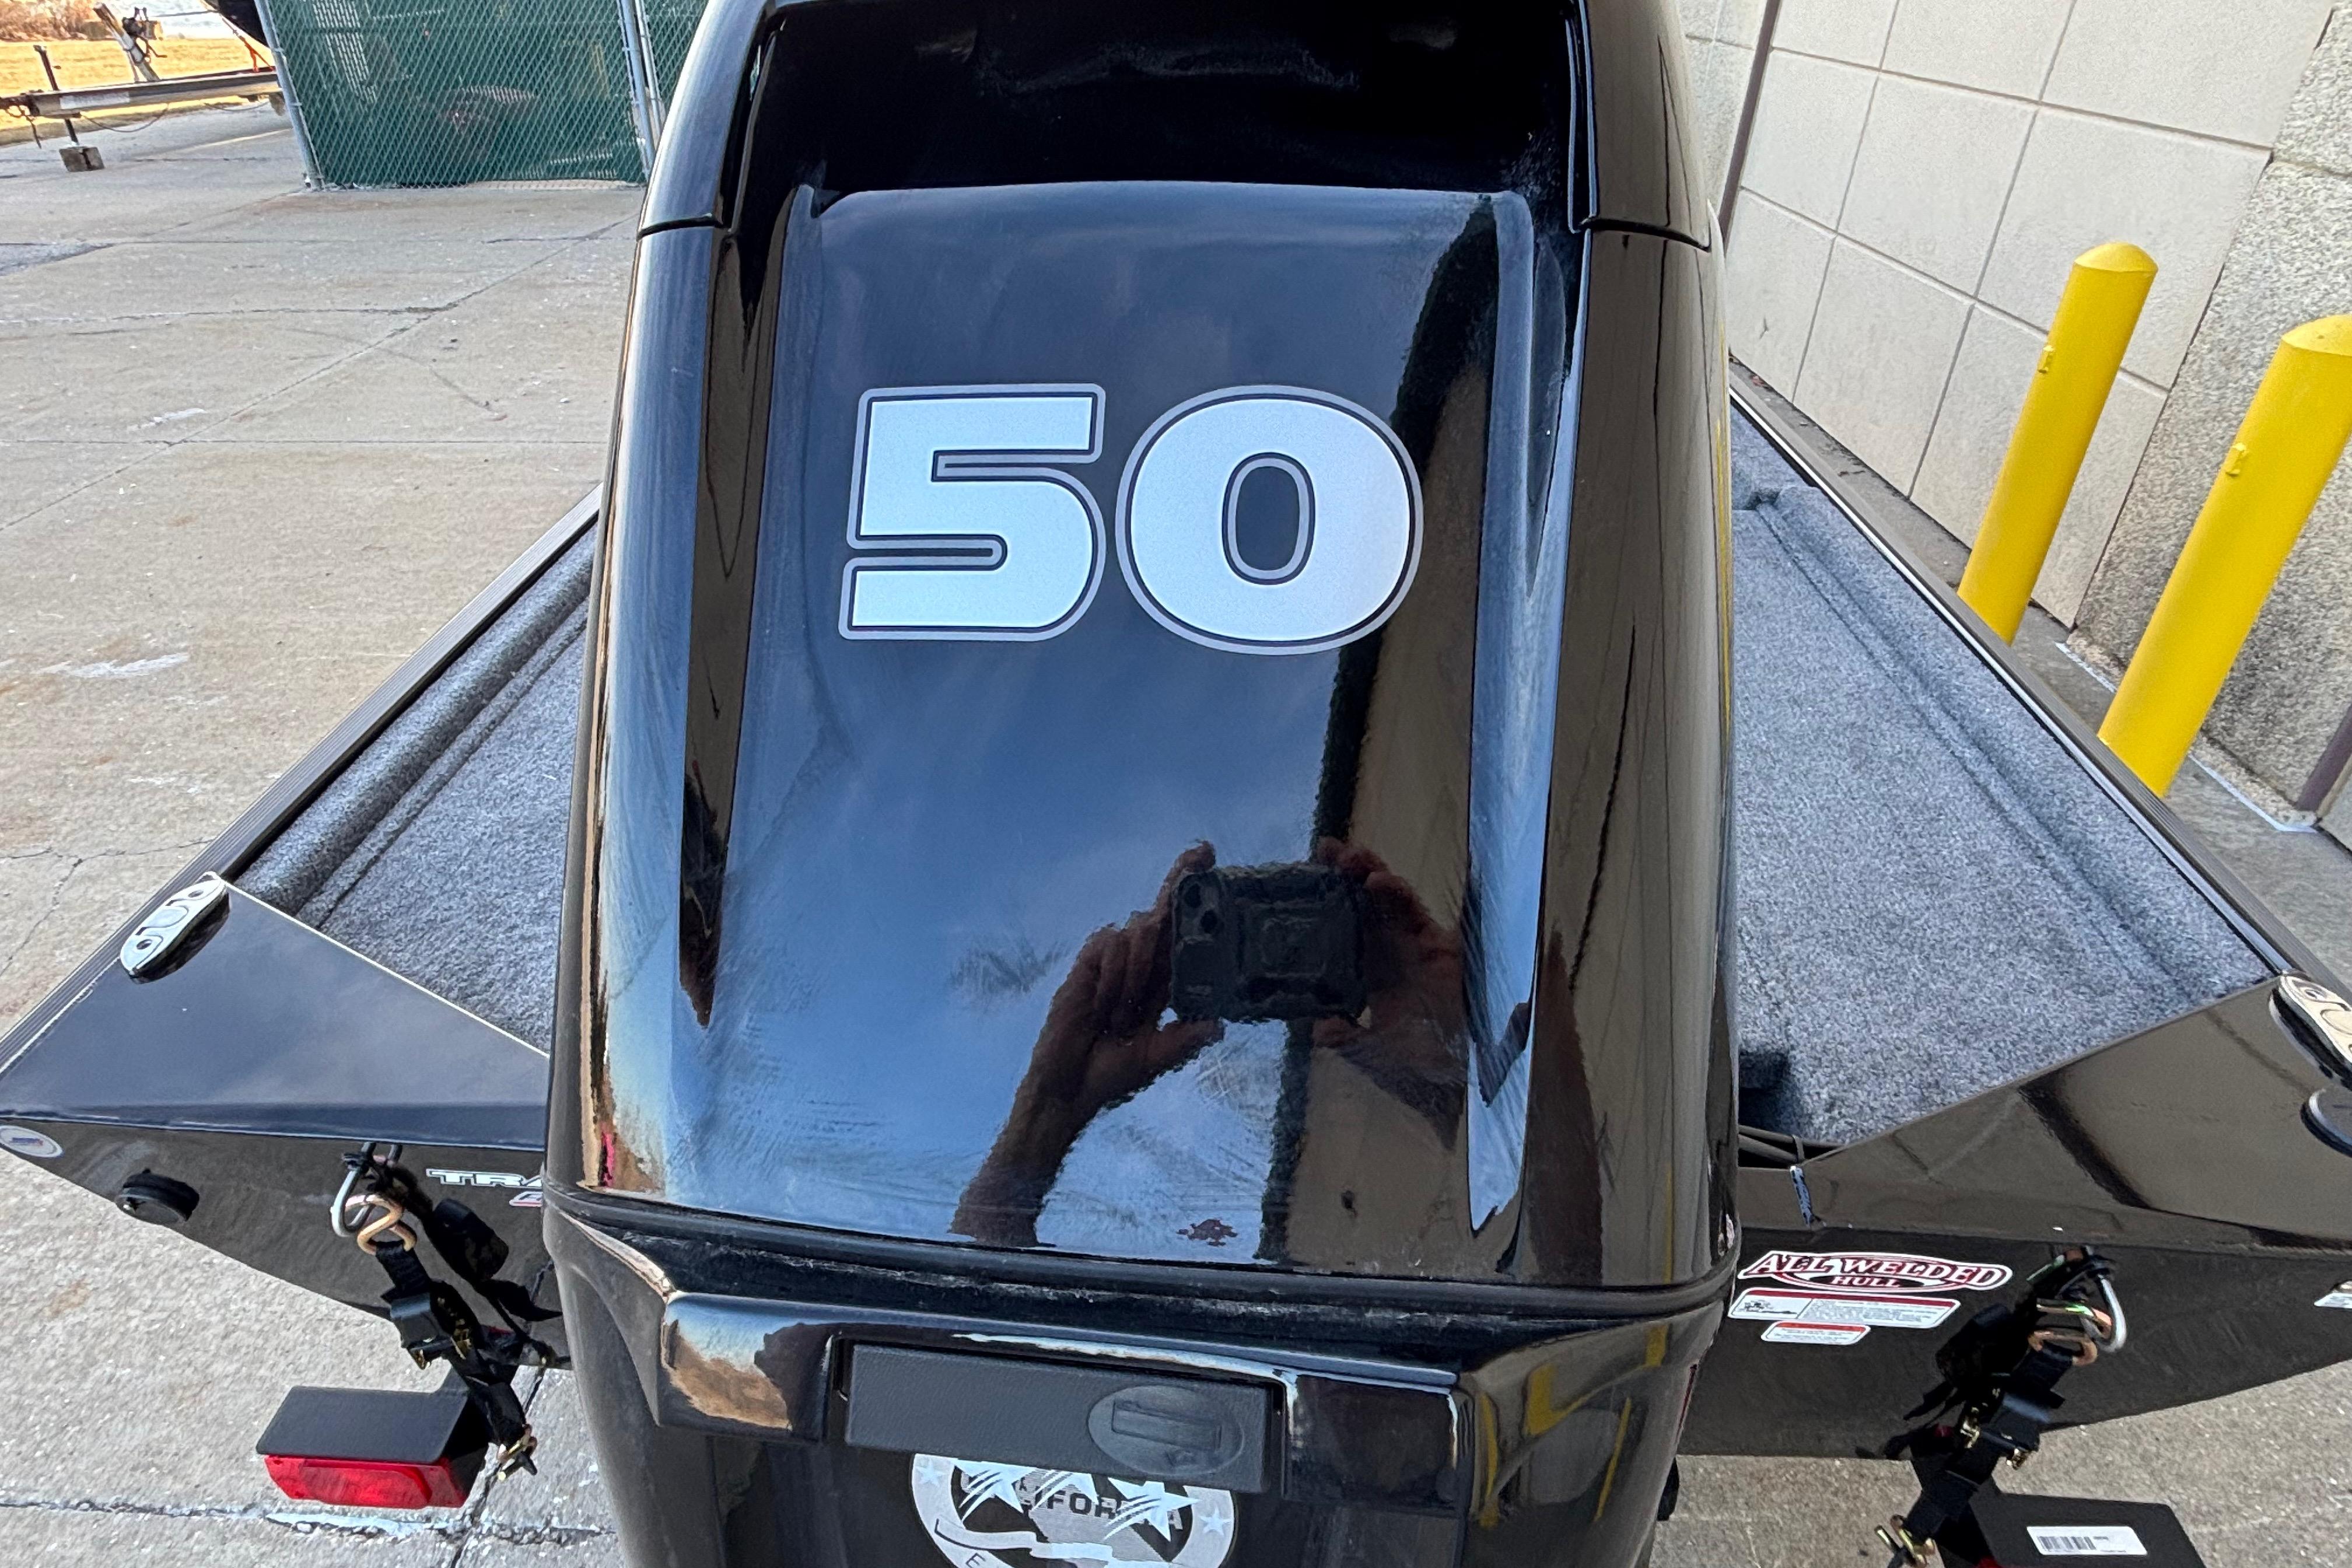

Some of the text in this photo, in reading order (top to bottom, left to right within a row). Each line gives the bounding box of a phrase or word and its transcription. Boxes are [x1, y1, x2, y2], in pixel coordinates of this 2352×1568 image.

[838, 383, 1423, 655] 50
[1748, 1254, 2004, 1284] ALL WELDED
[1831, 1276, 1900, 1287] HULL
